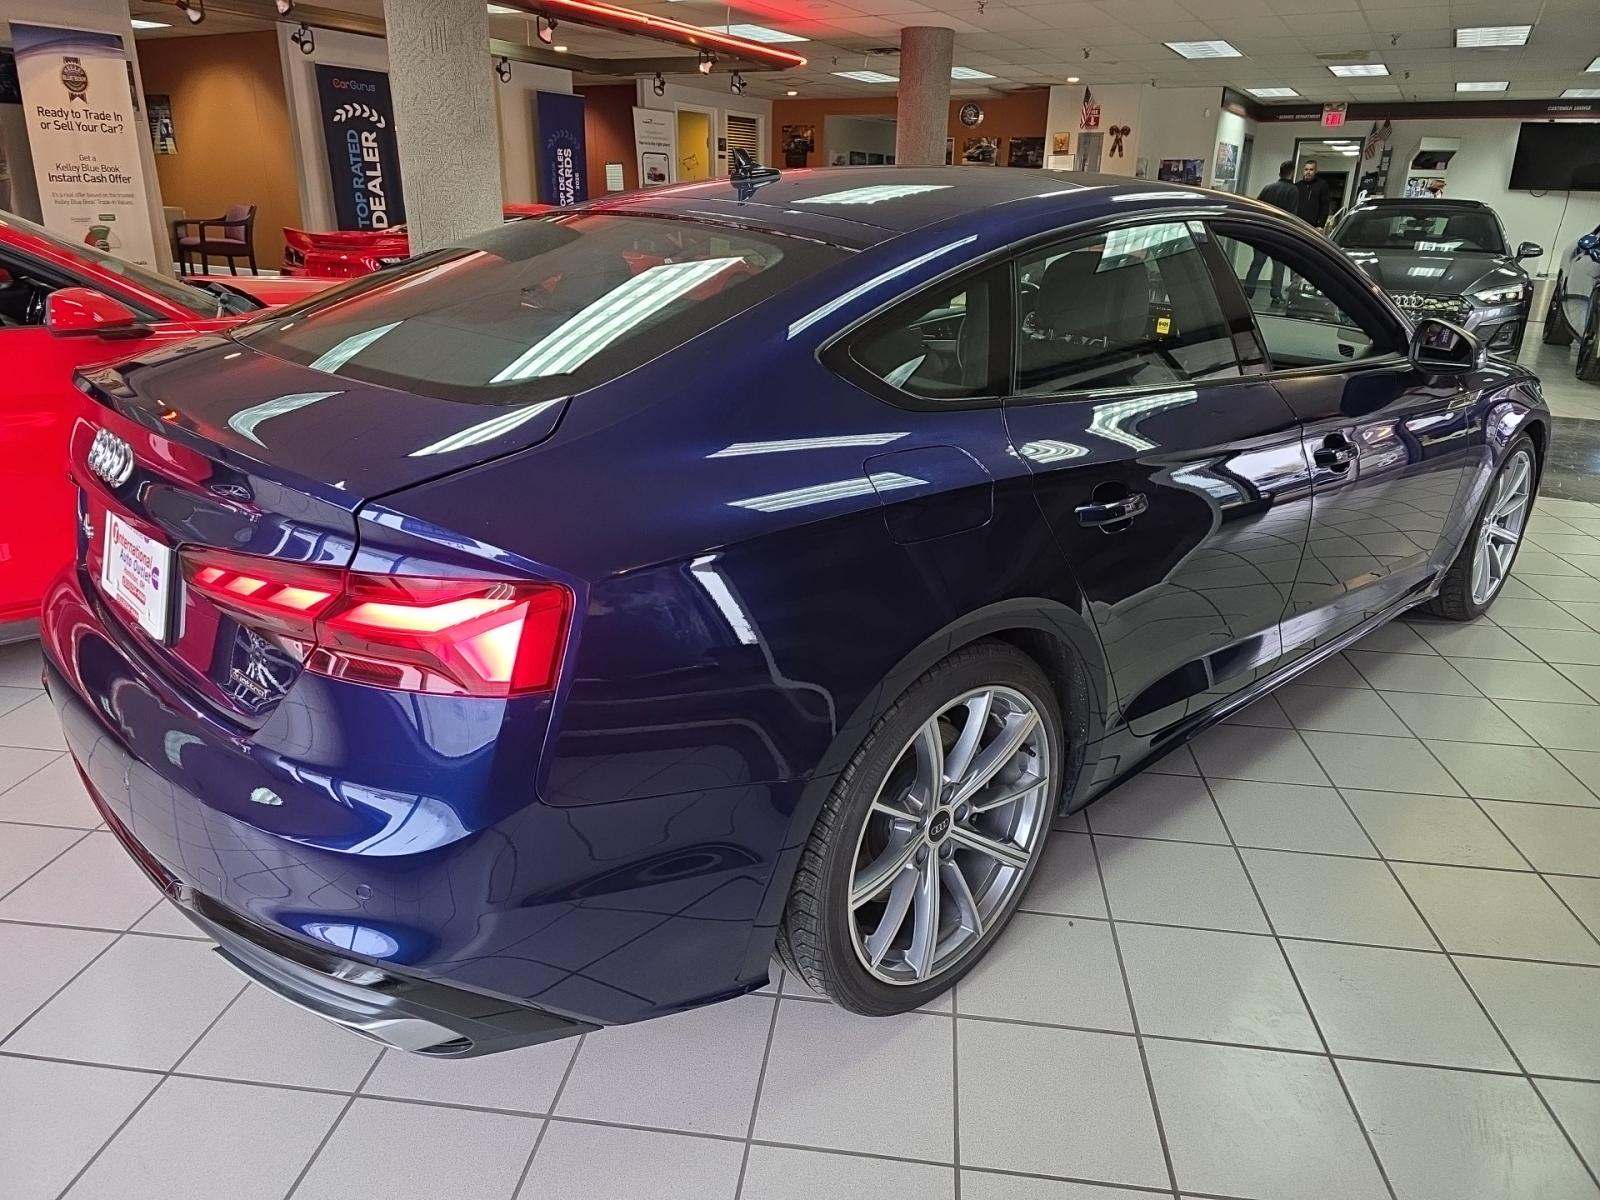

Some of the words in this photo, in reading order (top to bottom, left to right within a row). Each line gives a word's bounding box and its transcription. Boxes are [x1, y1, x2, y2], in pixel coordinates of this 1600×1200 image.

[332, 78, 376, 92] CarGurus
[37, 106, 69, 121] Ready
[71, 110, 81, 119] to
[83, 109, 112, 121] Trade
[113, 112, 123, 122] In
[40, 121, 51, 130] or
[53, 120, 74, 131] Sell
[75, 121, 98, 133] Your
[100, 123, 124, 134] Car?
[56, 163, 80, 173] Kelley
[81, 163, 100, 173] Blue
[101, 164, 120, 173] Book
[79, 154, 91, 162] Get
[346, 129, 365, 189] RATED
[557, 148, 565, 191] DEALER
[48, 173, 81, 183] Instant
[83, 173, 107, 184] Cash
[108, 173, 132, 184] Offer
[361, 131, 389, 229] DEALER
[355, 193, 370, 229] TOP
[113, 521, 153, 570] International
[120, 548, 132, 568] Auto
[133, 559, 152, 585] Outlet
